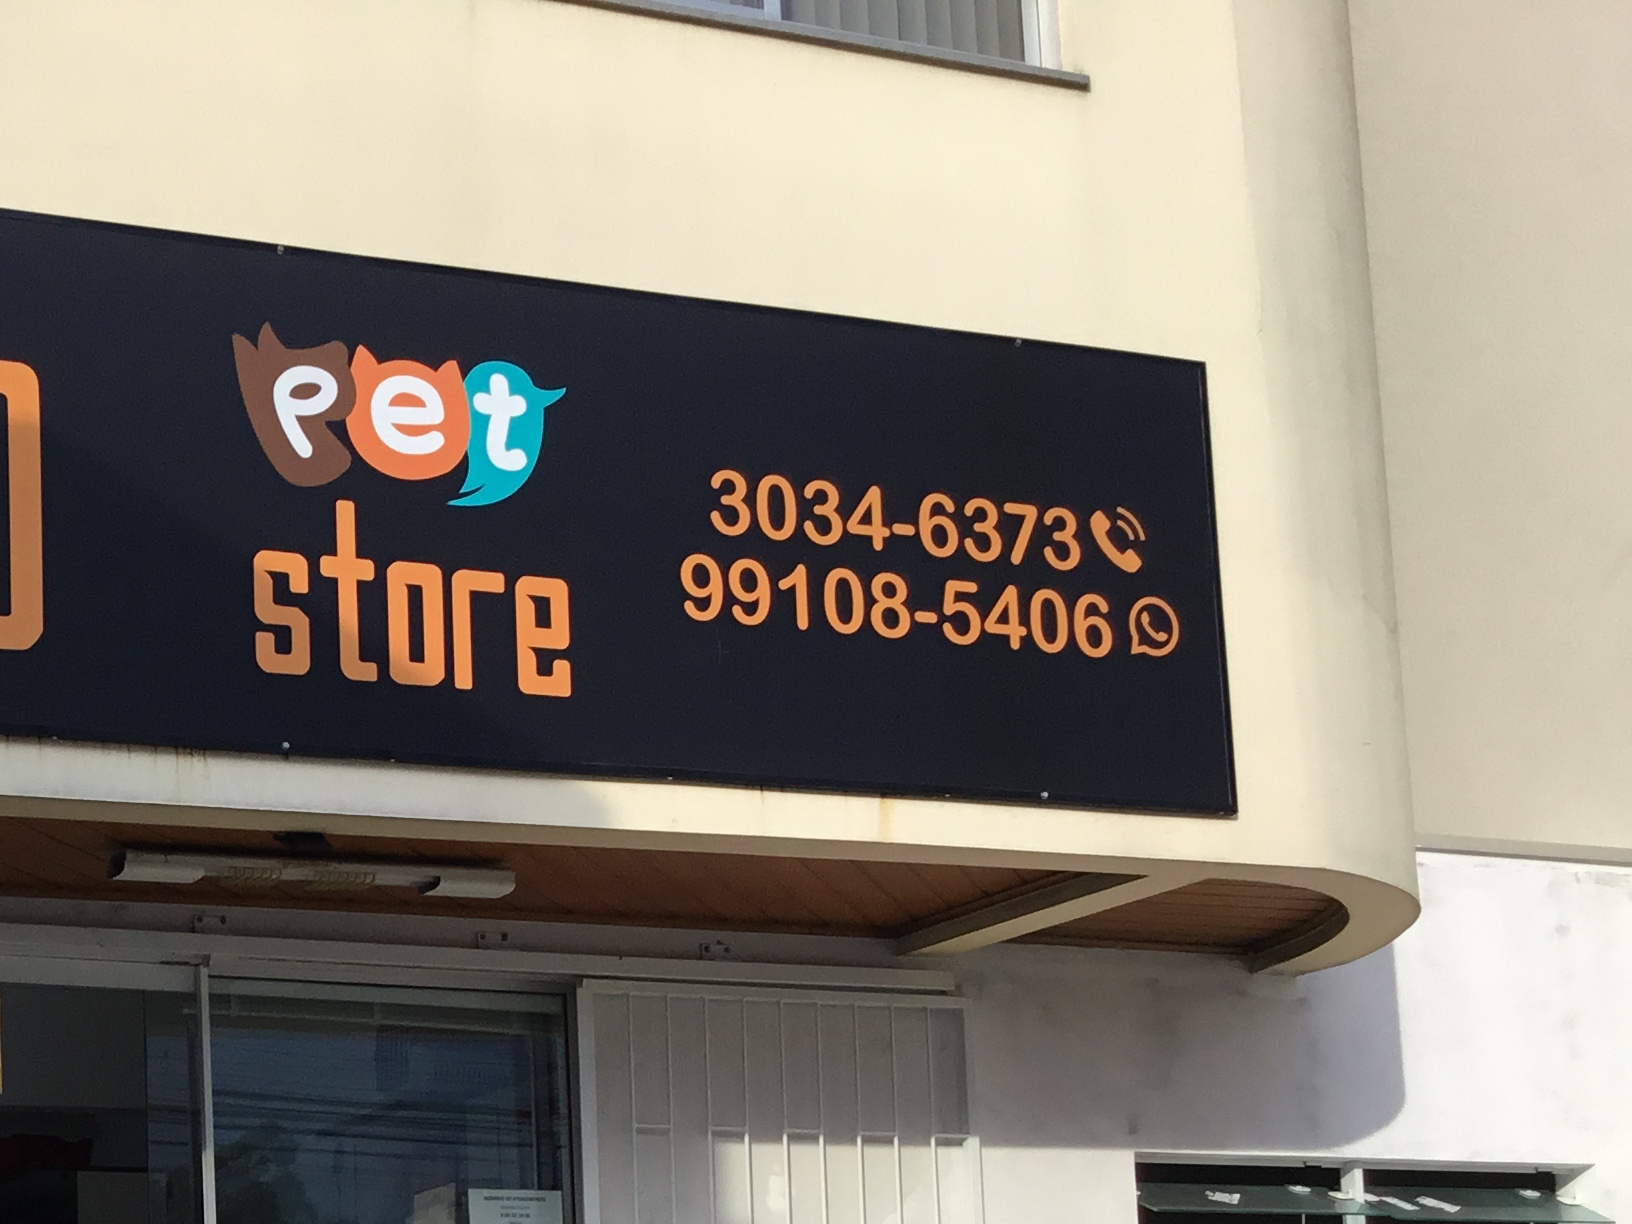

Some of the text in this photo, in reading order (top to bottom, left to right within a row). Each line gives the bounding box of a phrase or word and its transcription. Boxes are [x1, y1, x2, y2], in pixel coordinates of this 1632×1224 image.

[710, 470, 1081, 570] 3034-6373
[253, 500, 571, 698] store
[680, 554, 1113, 658] 99108-5406
